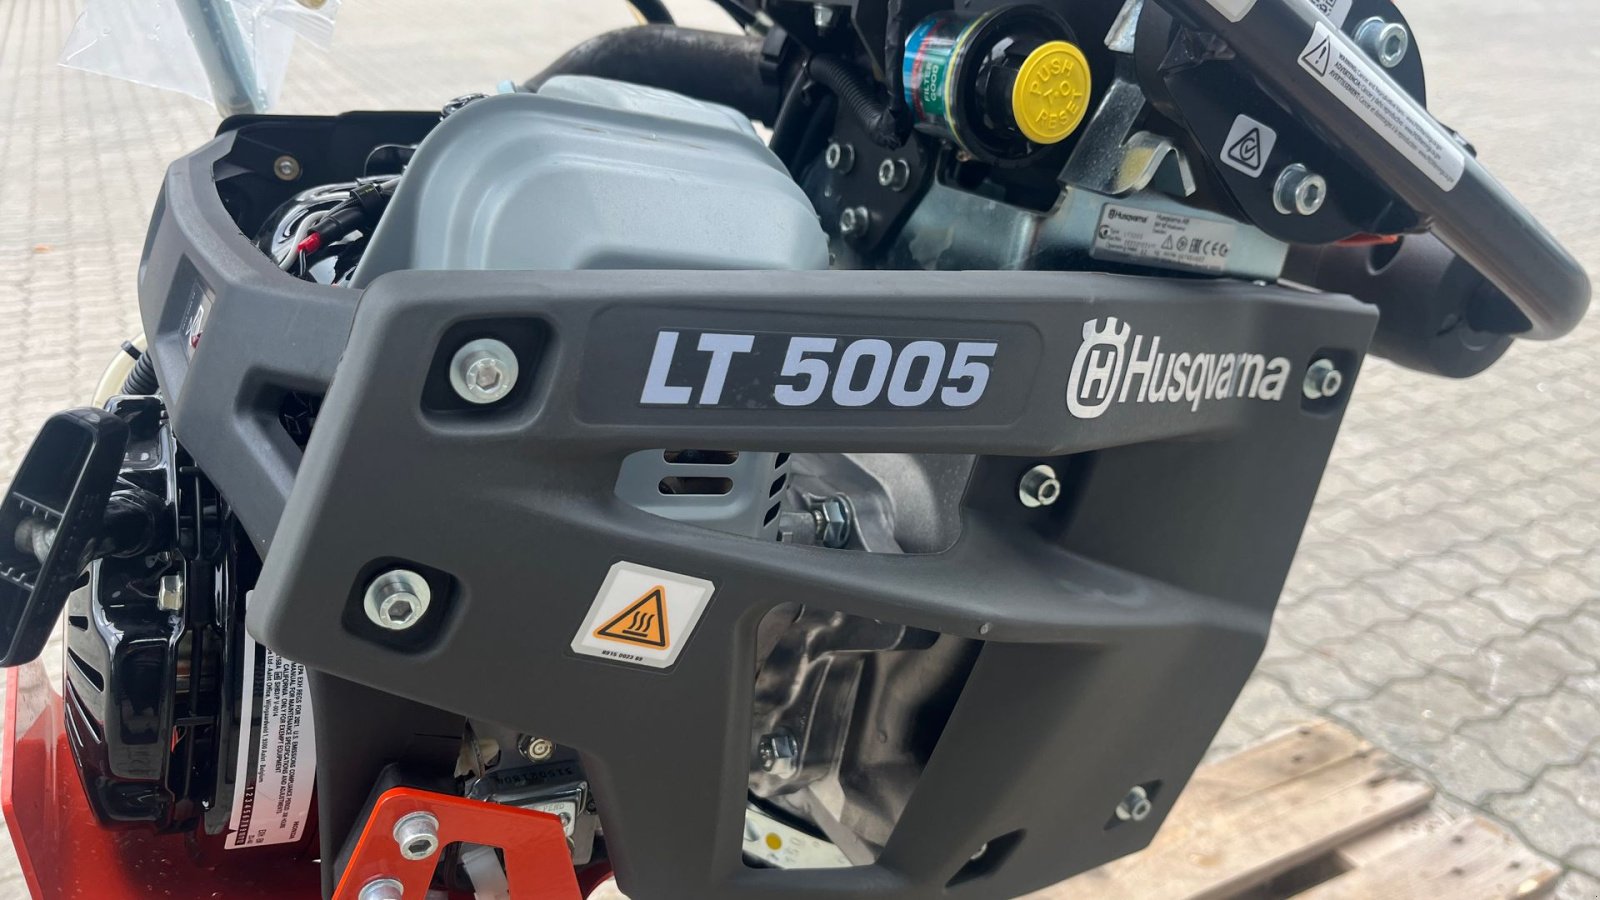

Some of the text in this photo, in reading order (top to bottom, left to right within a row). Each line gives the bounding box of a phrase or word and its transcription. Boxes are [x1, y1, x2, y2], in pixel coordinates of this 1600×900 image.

[924, 61, 933, 102] FILTER
[930, 65, 939, 101] GOOD
[1030, 58, 1075, 95] PUSH
[1036, 89, 1082, 129] RESET
[1115, 211, 1148, 224] Husqvarna
[640, 331, 998, 407] LT 5005
[1117, 336, 1291, 412] Husqvarna
[286, 699, 294, 736] MAINTENANCE
[282, 737, 291, 774] SPECIFICATIONS
[289, 742, 298, 768] EMISSIONS
